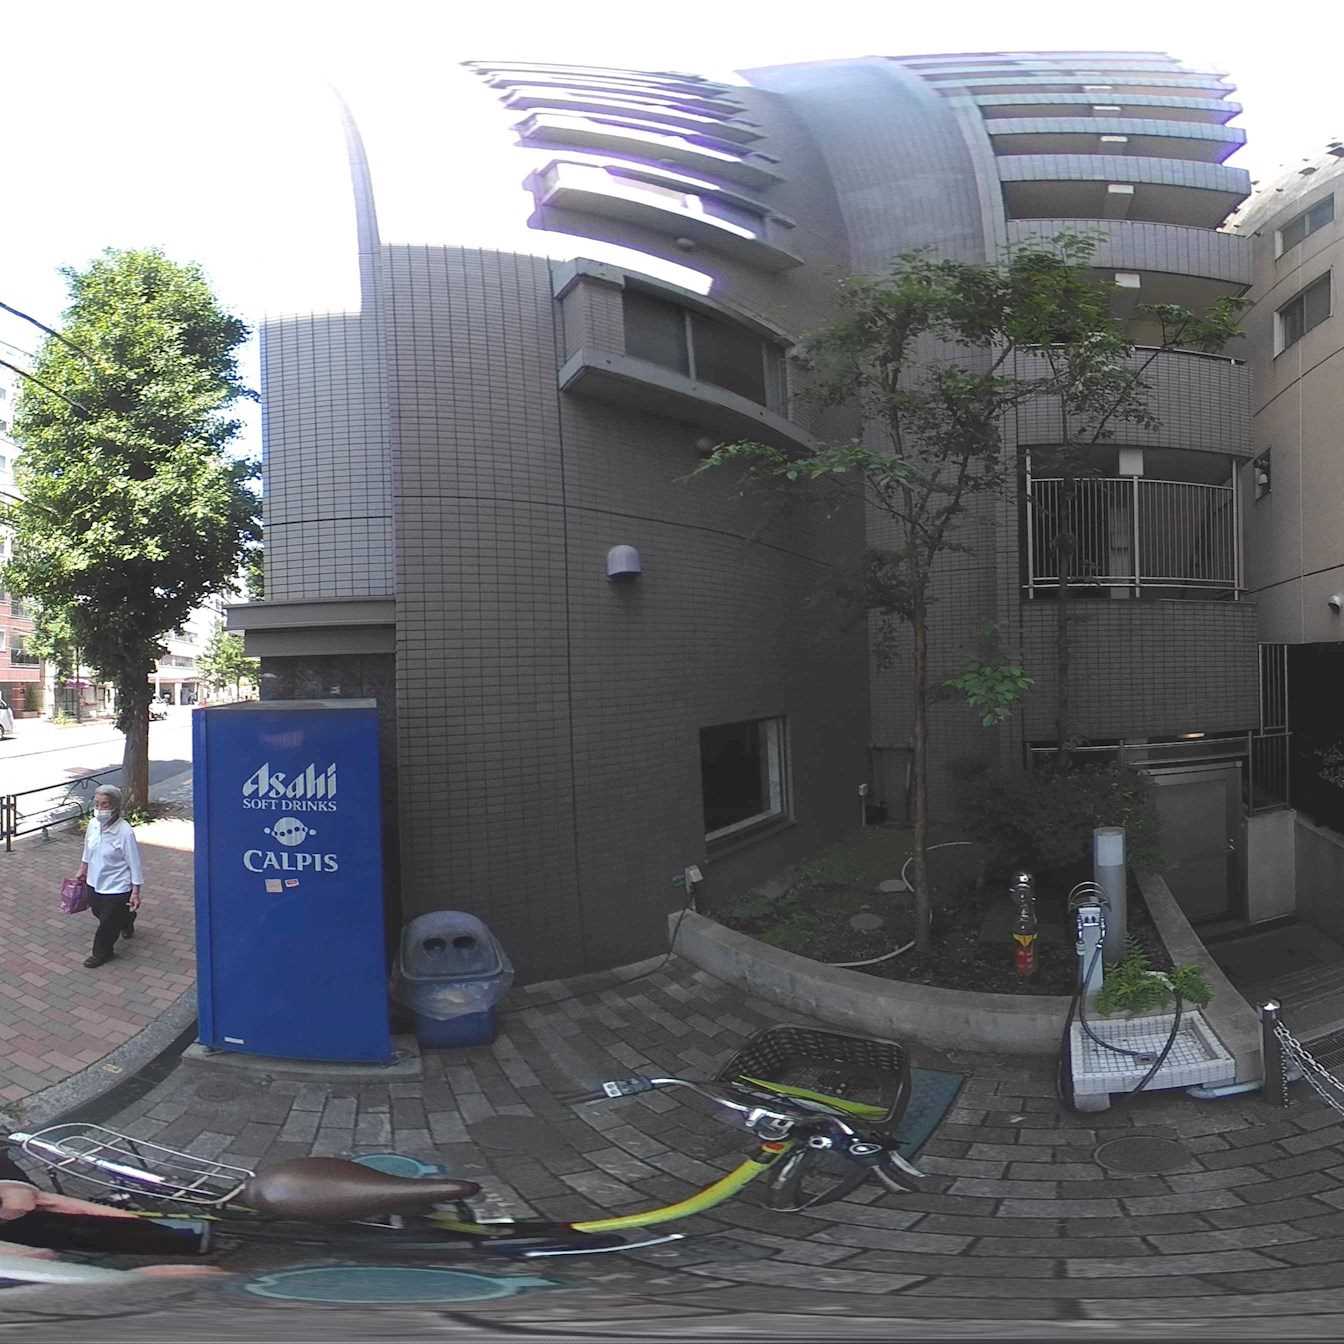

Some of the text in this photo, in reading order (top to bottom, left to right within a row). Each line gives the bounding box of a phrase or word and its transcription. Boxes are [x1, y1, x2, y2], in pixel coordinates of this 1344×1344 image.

[242, 762, 336, 799] Asahi
[243, 798, 337, 812] SOFT DRINKS
[243, 849, 339, 873] CALPIS
